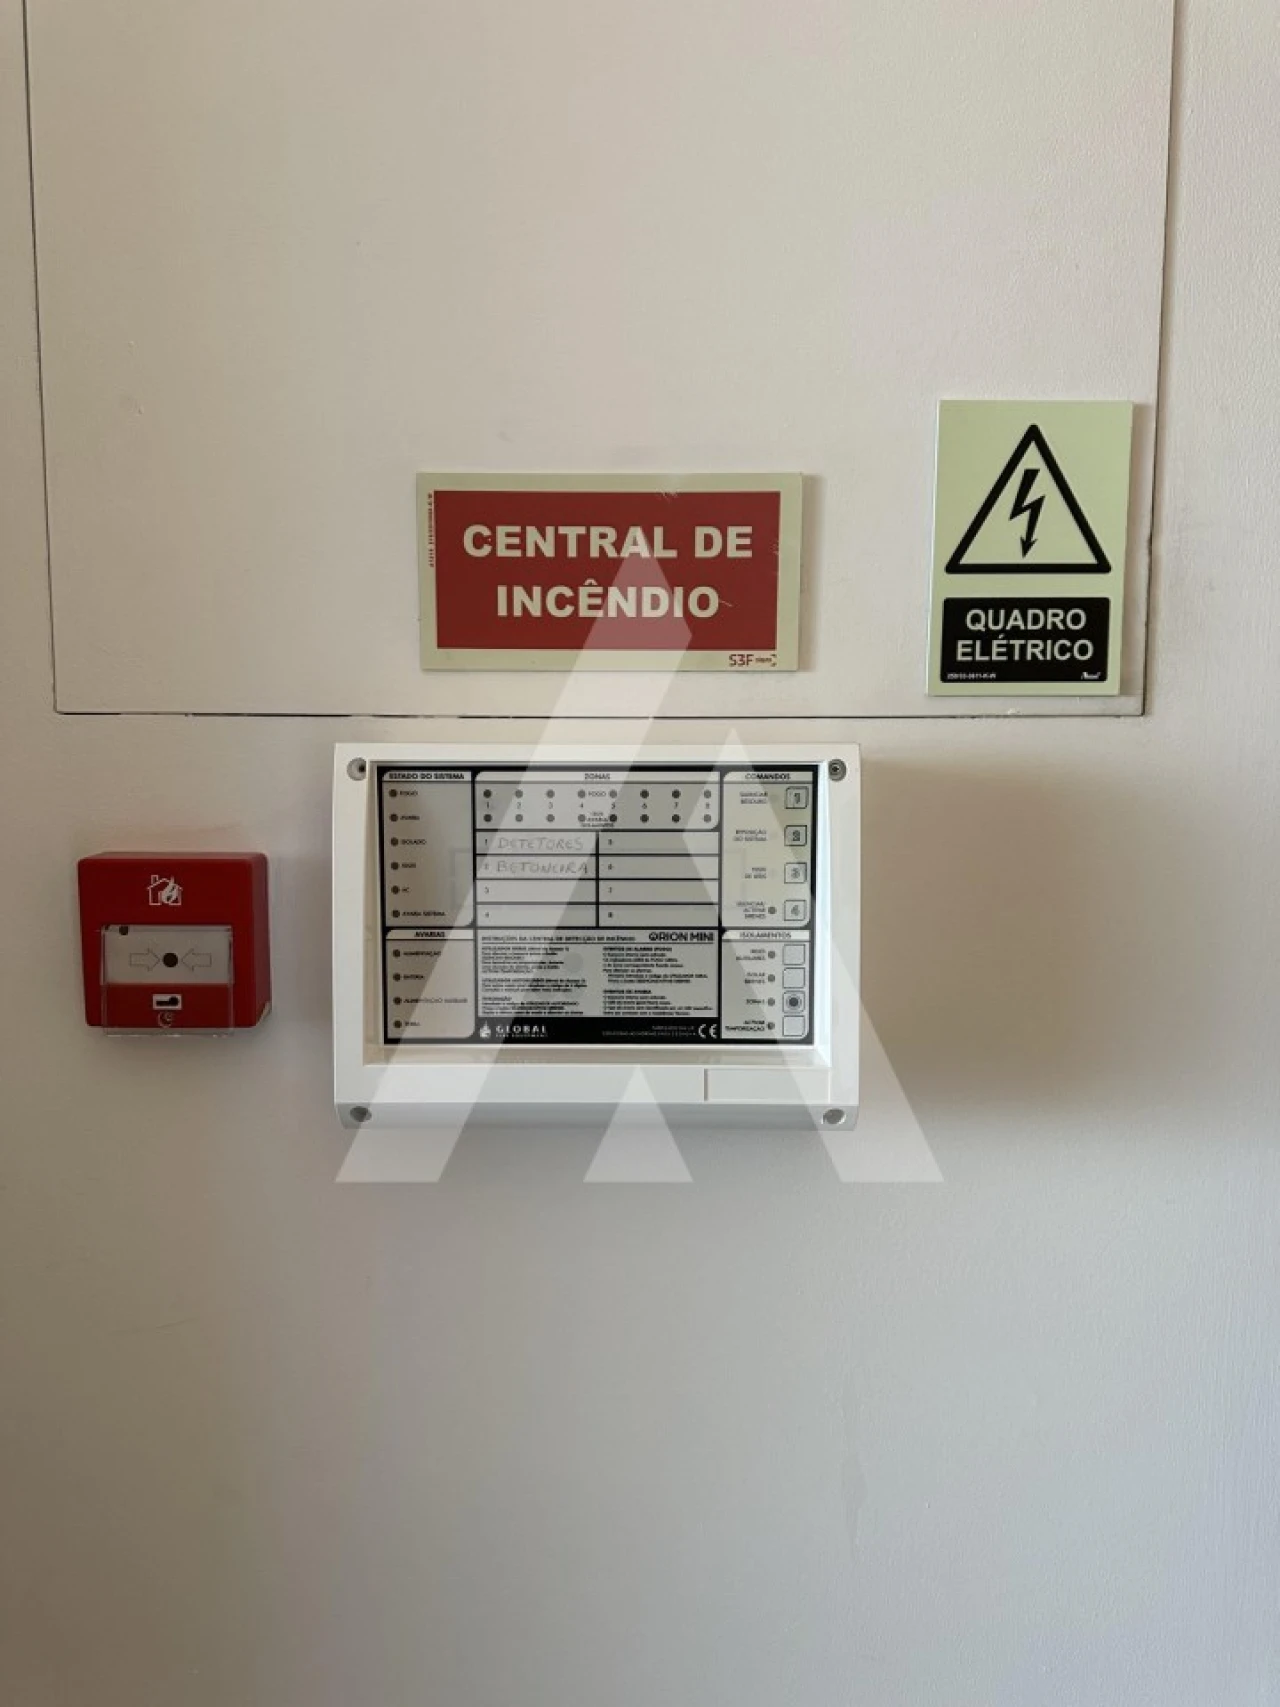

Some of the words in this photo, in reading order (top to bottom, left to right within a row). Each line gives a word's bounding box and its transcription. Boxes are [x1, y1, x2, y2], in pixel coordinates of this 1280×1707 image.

[463, 524, 678, 558] CENTRAL
[694, 525, 753, 558] DE
[496, 578, 720, 619] INCÊNDIO
[965, 608, 1087, 632] QUADRO
[956, 635, 1094, 661] ELÉTRICO
[389, 772, 418, 780] ESTADO
[420, 772, 432, 780] DO
[434, 772, 465, 780] SISTEMA
[584, 772, 611, 780] ZONAS
[745, 772, 791, 780] COMANDOS
[649, 931, 688, 941] ORION
[690, 931, 714, 941] MINI
[495, 1025, 546, 1034] GLOBAL
